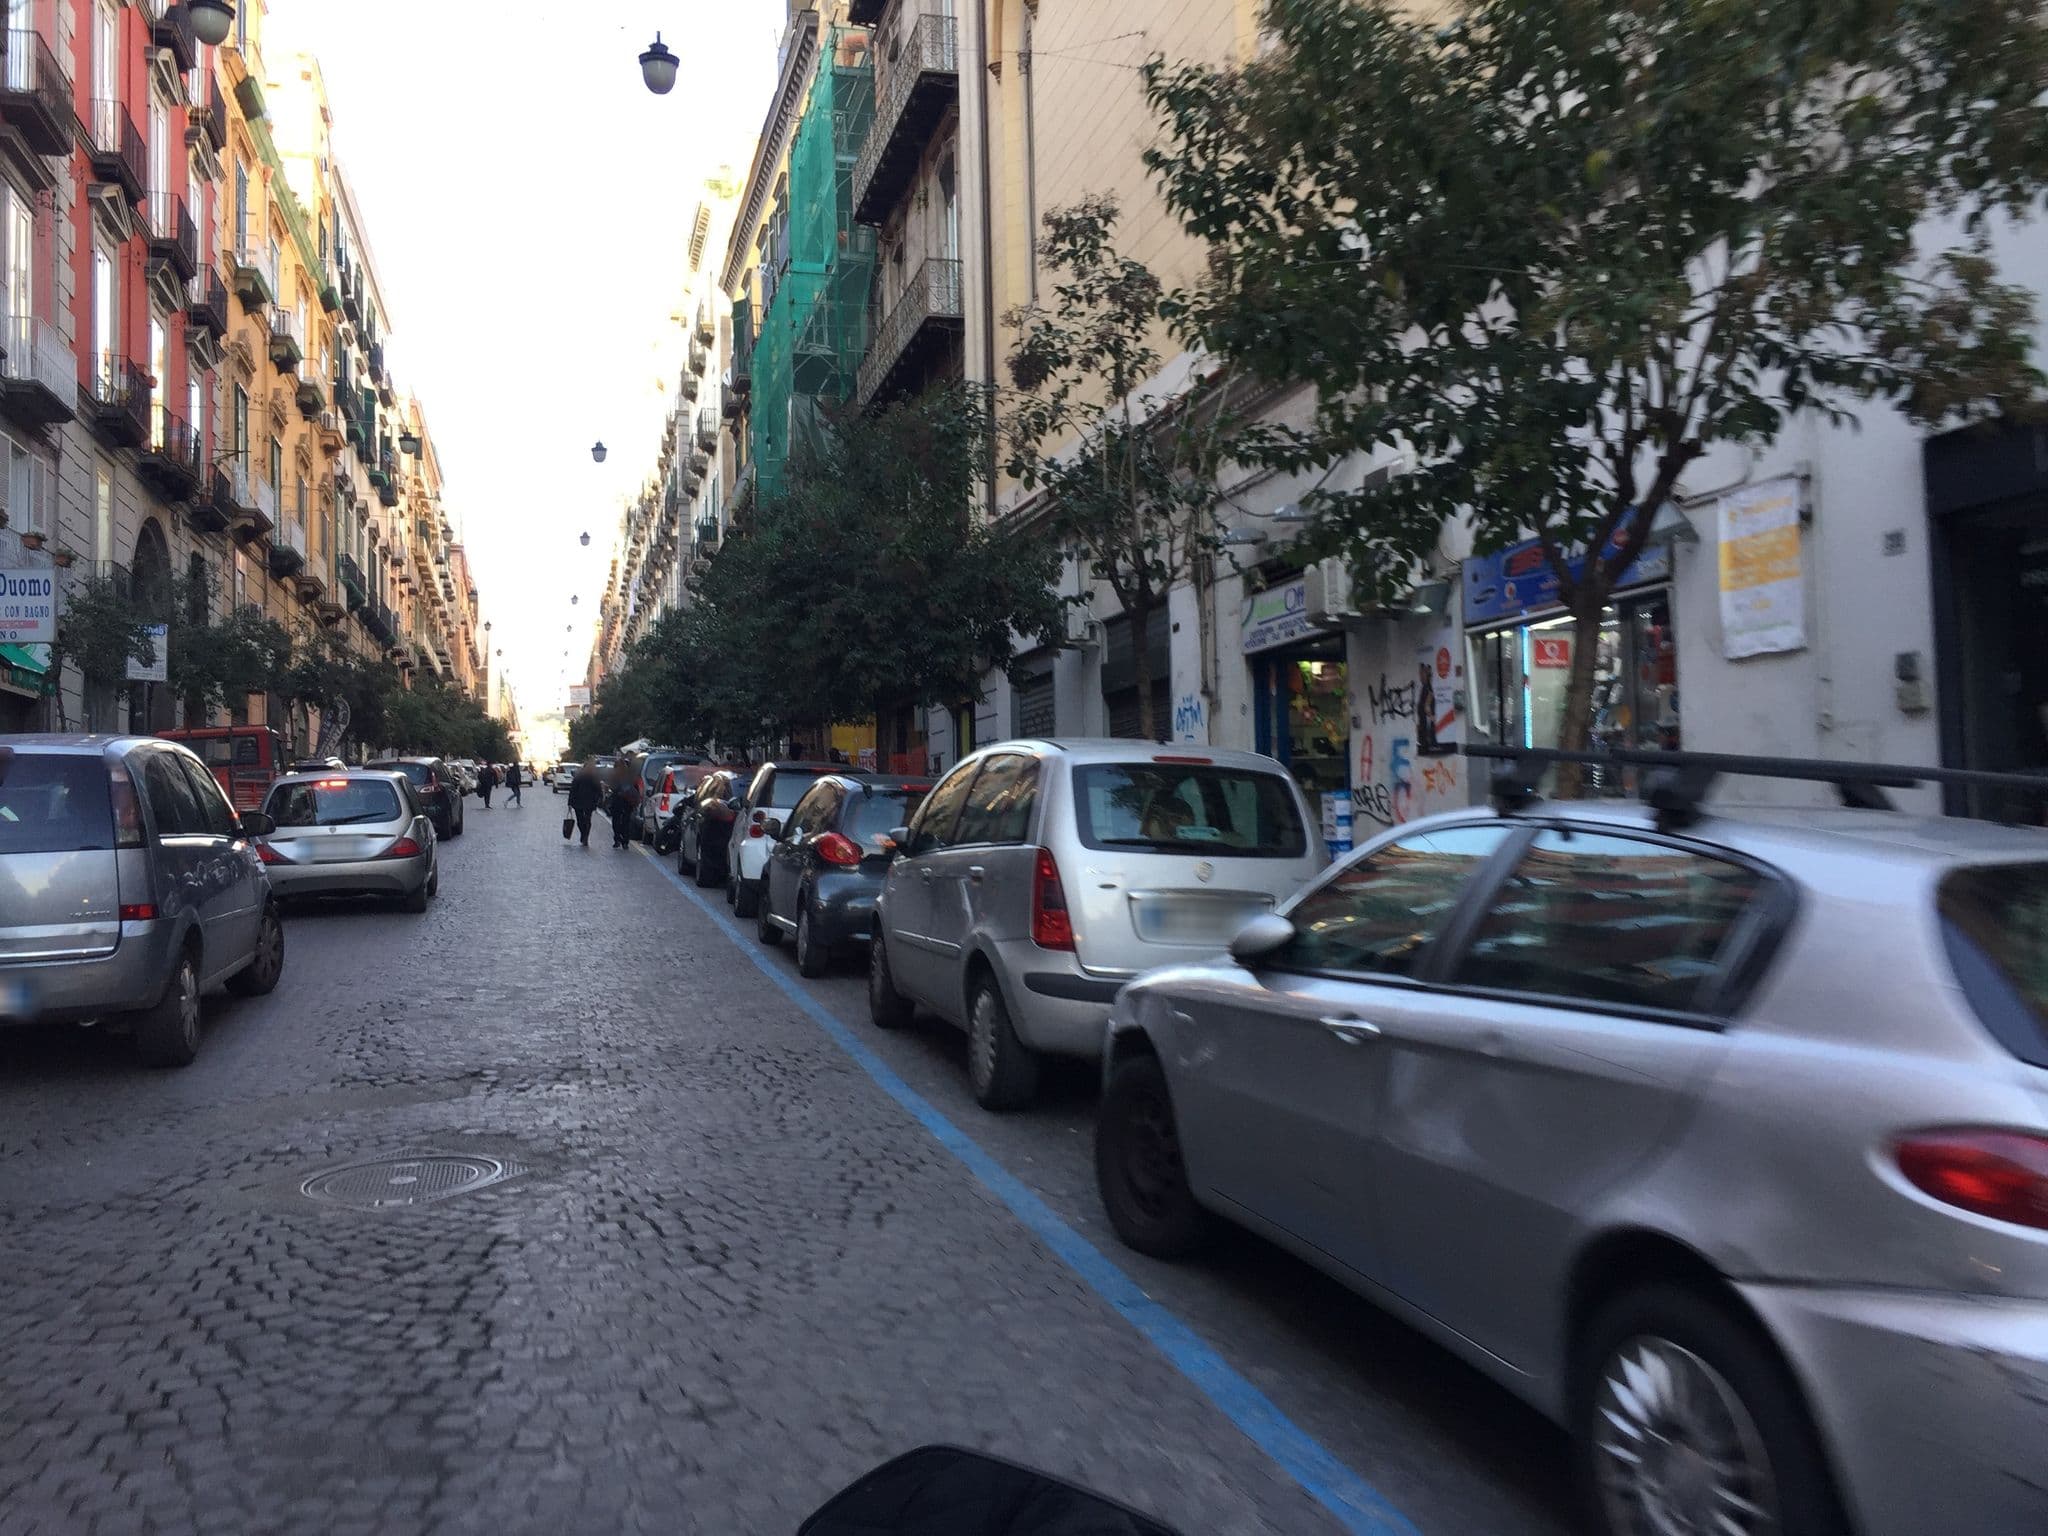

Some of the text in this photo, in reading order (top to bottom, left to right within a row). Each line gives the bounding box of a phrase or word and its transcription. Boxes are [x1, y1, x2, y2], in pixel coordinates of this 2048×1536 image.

[0, 573, 51, 597] Duomo
[4, 605, 50, 618] CON BAGNO
